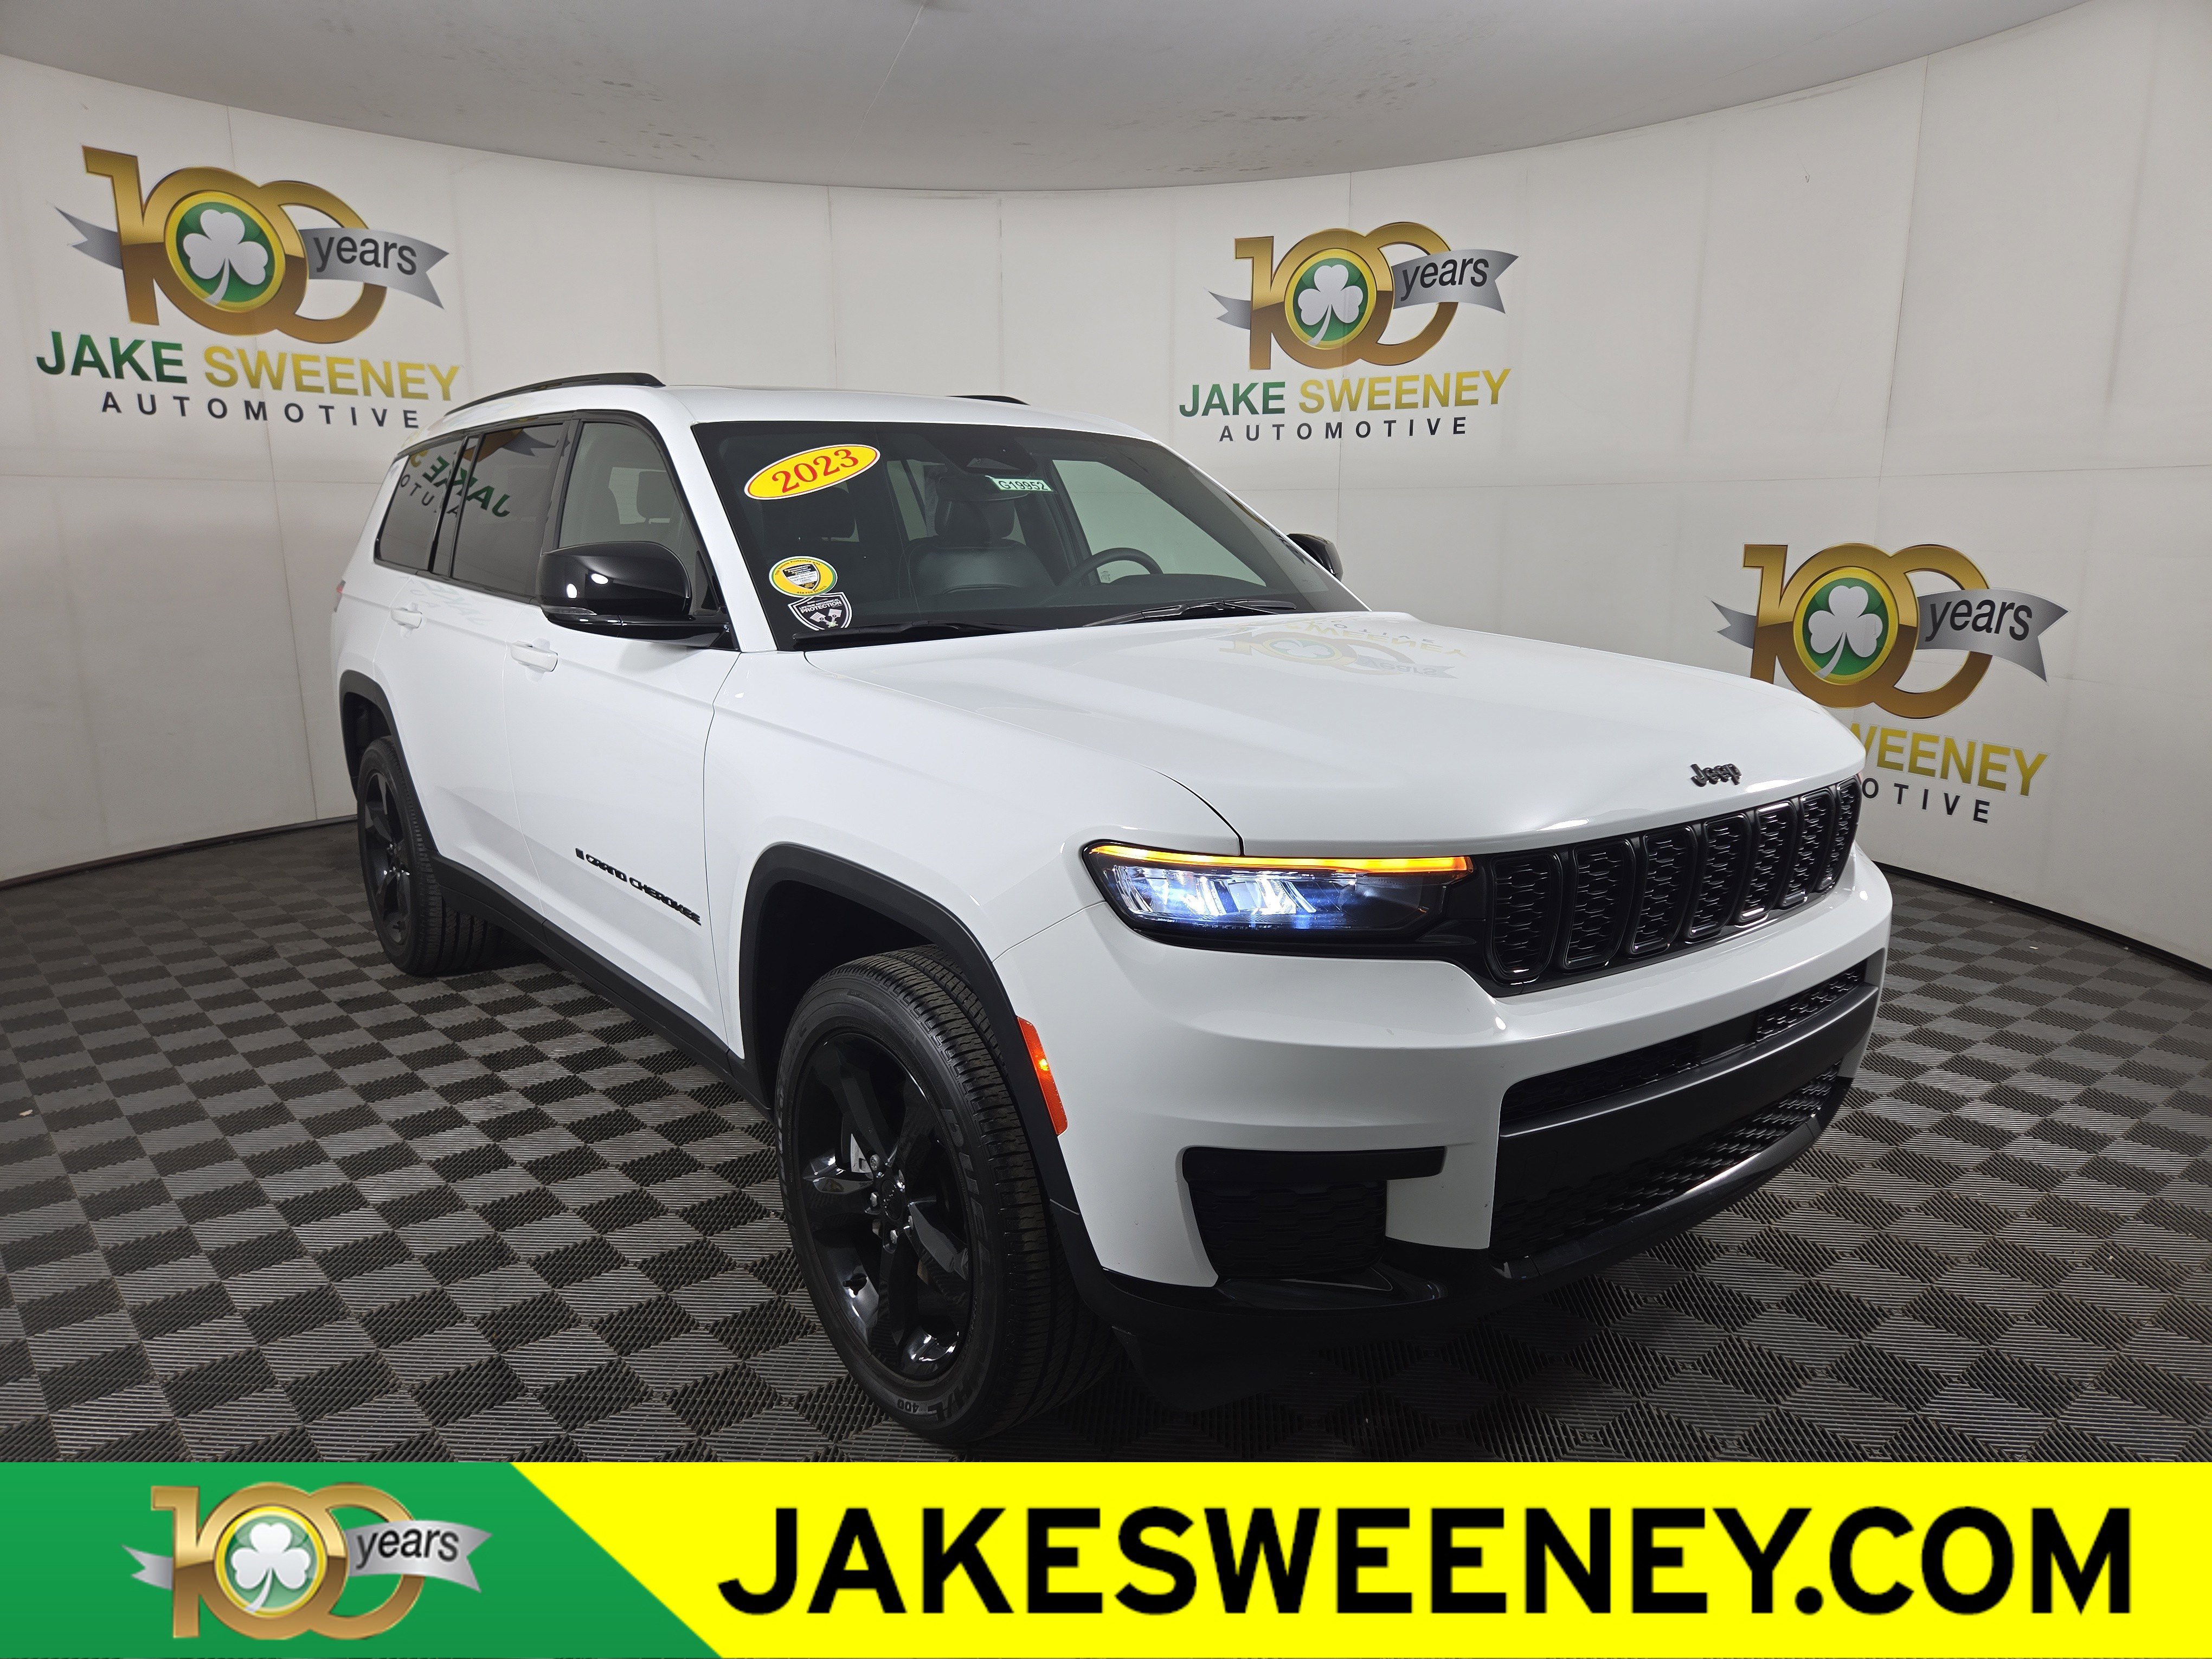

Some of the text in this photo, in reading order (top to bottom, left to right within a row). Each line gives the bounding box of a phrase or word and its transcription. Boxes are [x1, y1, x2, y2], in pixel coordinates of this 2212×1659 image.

[313, 236, 417, 275] years
[1400, 256, 1489, 301] years
[36, 330, 461, 402] JAKE SWEENEY
[102, 391, 420, 428] AUTOMOTIVE
[1179, 368, 1512, 417] JAKE SWEENEY
[1219, 417, 1467, 441] AUTOMOTIVE
[771, 448, 860, 493] 2023
[999, 480, 1048, 490] G19952
[800, 600, 843, 613] PROTECTION
[1925, 599, 2033, 642] years
[1690, 763, 1742, 787] Jeep
[586, 854, 702, 926] GRAND CHEROKEE
[897, 1398, 919, 1413] 400
